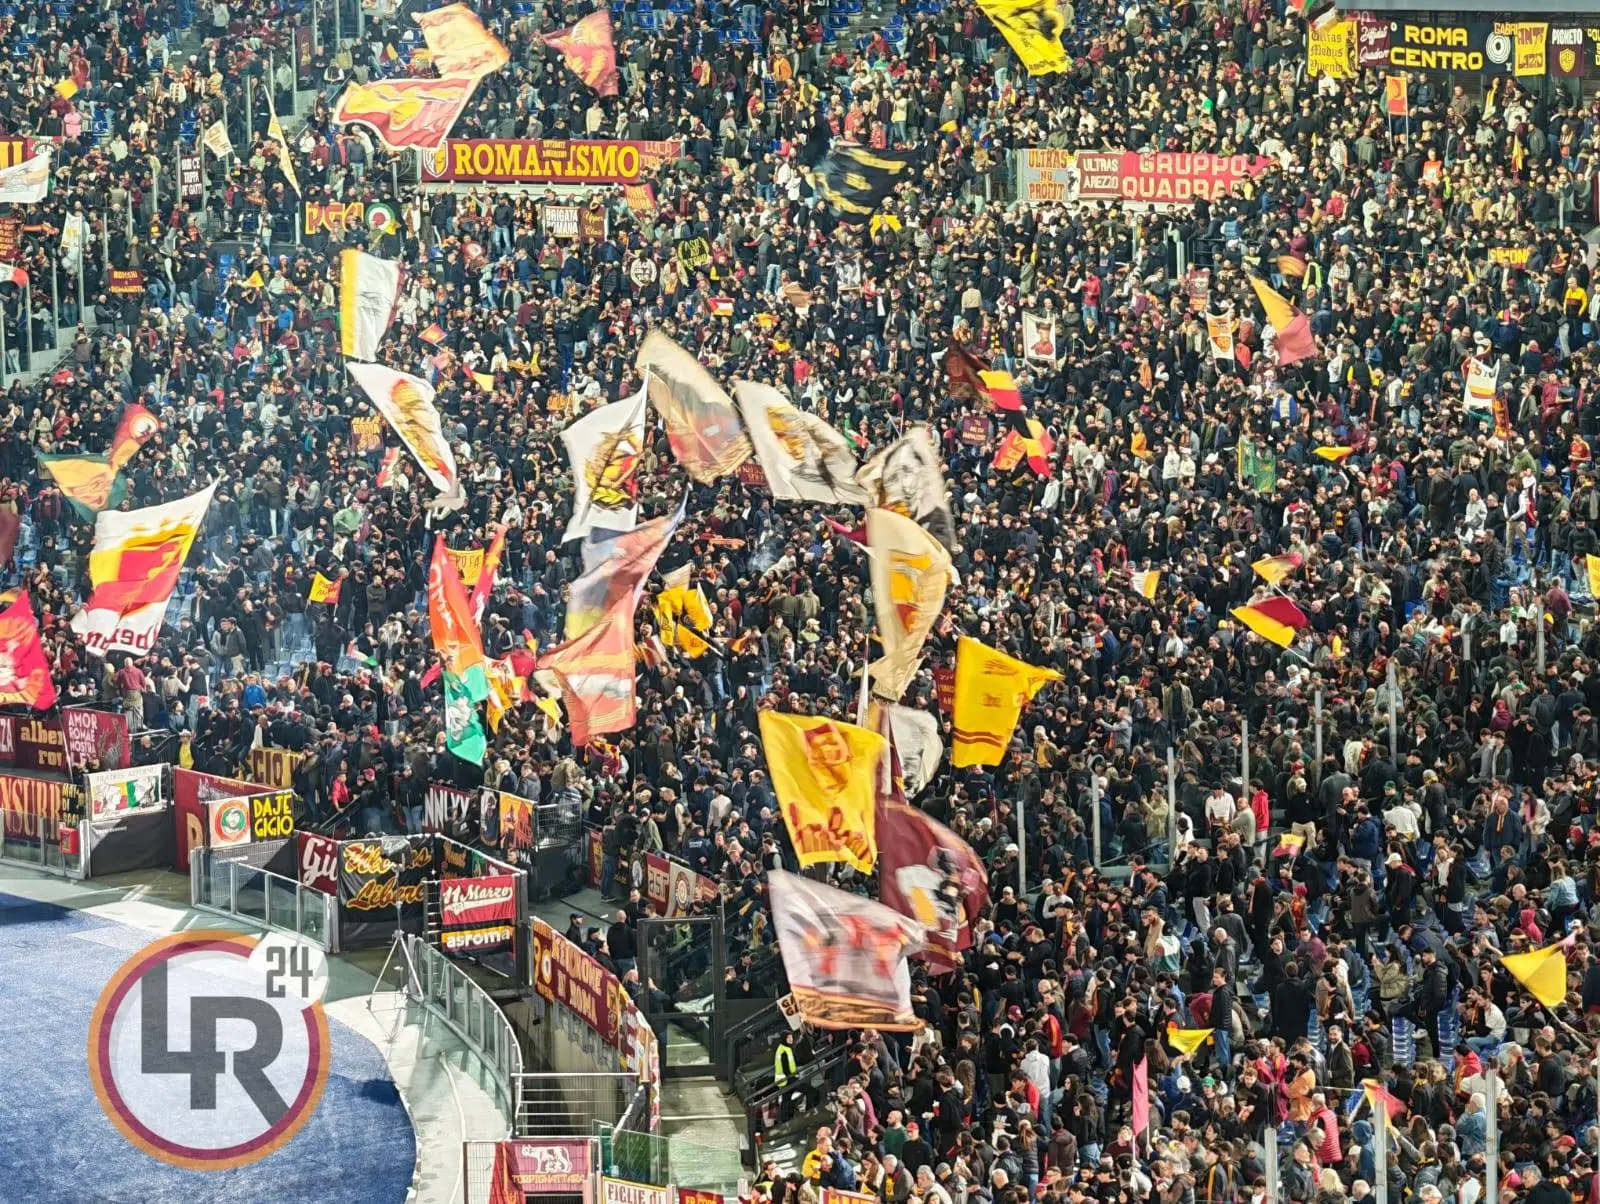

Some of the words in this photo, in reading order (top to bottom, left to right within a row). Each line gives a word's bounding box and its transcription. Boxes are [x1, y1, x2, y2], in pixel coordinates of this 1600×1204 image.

[1404, 25, 1468, 46] ROMA
[1389, 47, 1484, 70] CENTRO
[1083, 158, 1119, 173] ULTRAS
[1139, 154, 1248, 176] GRUPPO
[68, 711, 98, 730] AMOR
[253, 794, 293, 818] DAJE
[254, 815, 294, 838] GIGIO
[446, 927, 511, 949] asroma
